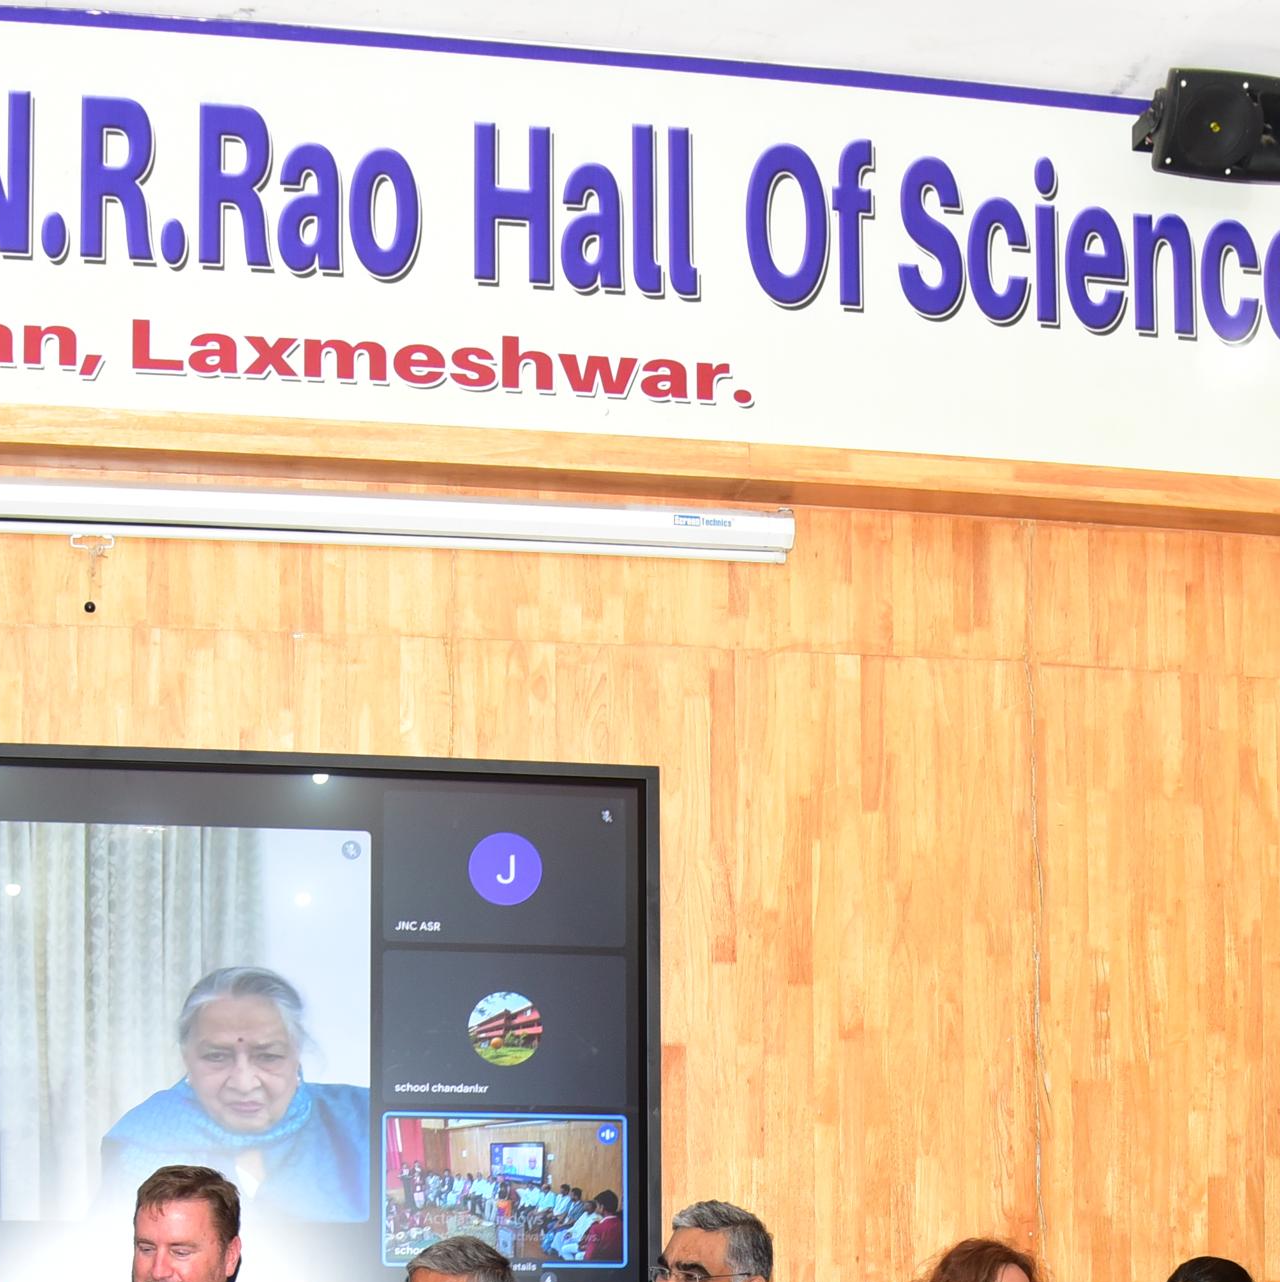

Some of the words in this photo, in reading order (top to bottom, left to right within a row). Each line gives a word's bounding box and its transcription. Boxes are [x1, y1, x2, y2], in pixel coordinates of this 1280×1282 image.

[476, 123, 700, 297] Hall
[747, 140, 873, 307] Of
[132, 319, 754, 405] Laxmeshwar.
[496, 854, 516, 884] J
[395, 921, 417, 931] JNC
[420, 922, 441, 932] ASR
[395, 1082, 429, 1093] school
